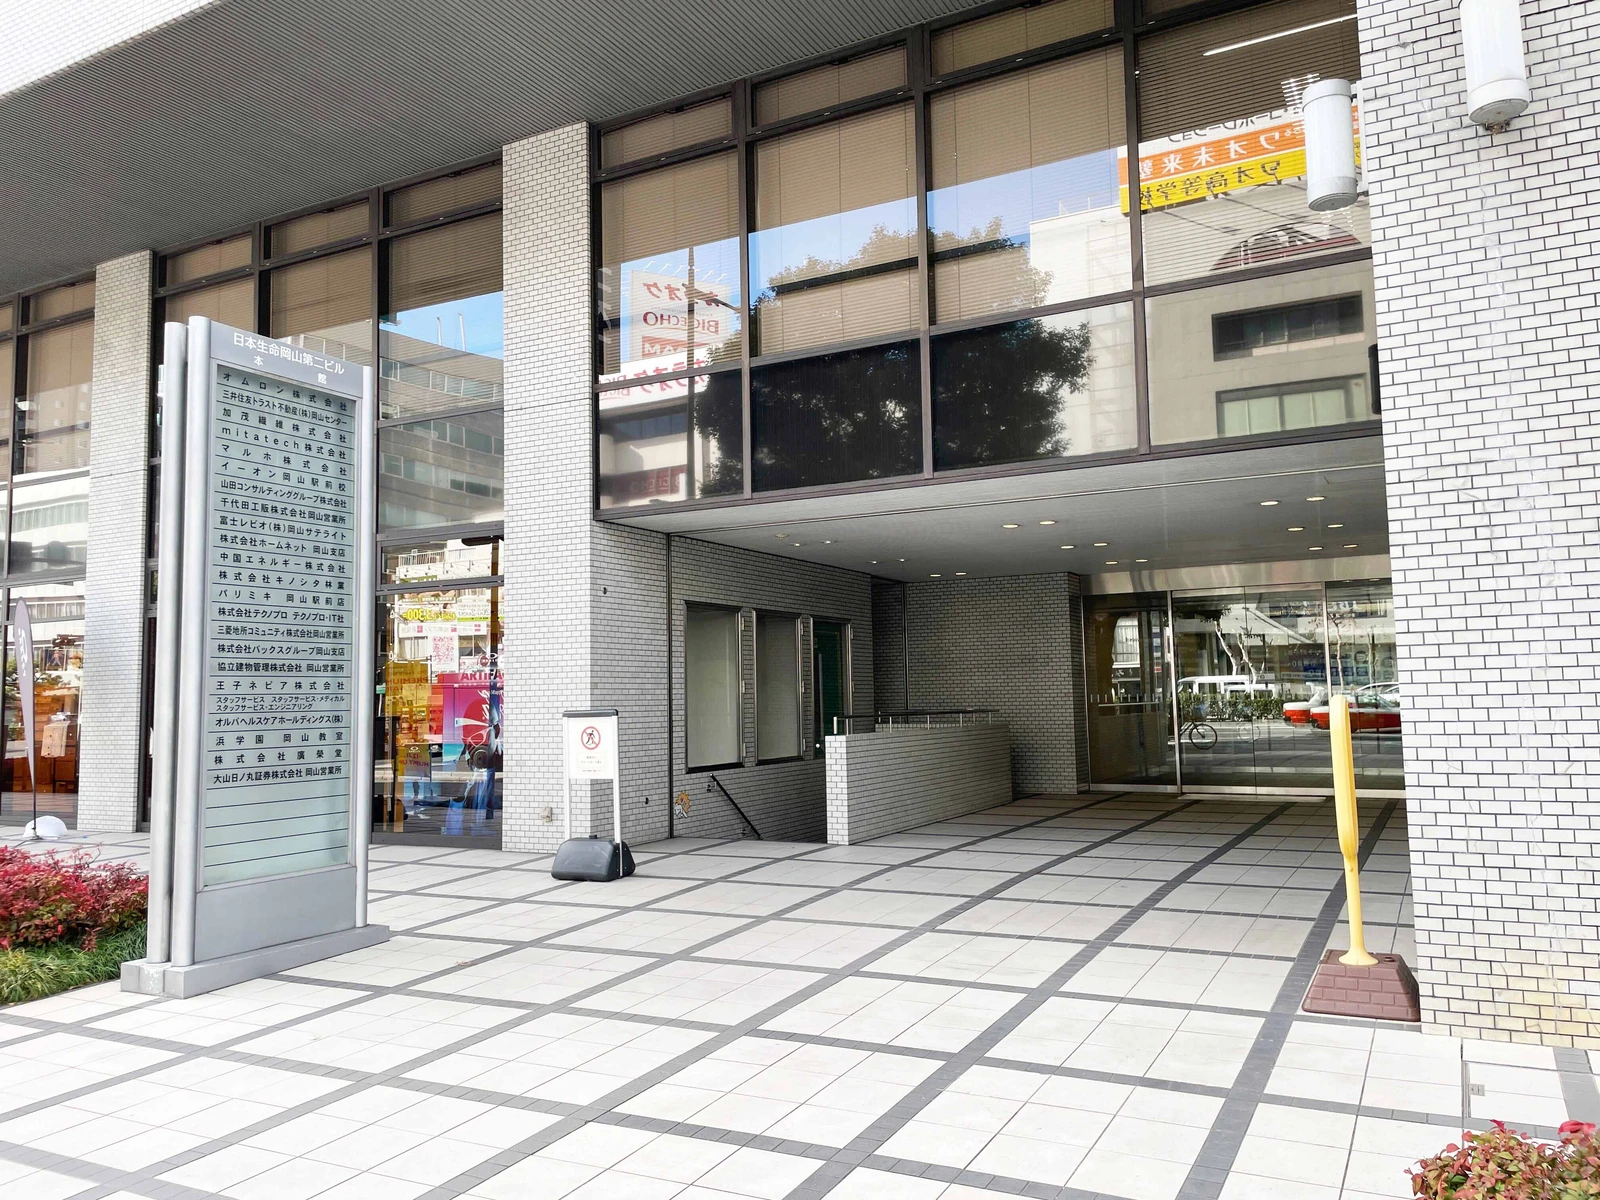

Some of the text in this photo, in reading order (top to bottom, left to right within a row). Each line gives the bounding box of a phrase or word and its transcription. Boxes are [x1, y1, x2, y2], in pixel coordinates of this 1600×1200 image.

[233, 332, 345, 375] 日本生命岡山第二ビル
[223, 372, 347, 412] オムロン株式会社
[222, 389, 347, 425] 三井住友トラスト不動産(株)岡山センター
[222, 407, 347, 443] 加茂繊維株式会社
[221, 444, 347, 476] マルホ株式会社
[221, 461, 346, 492] イーオン岡山駅前校
[221, 479, 347, 509] 山田コンサルティンググループ株式会社
[219, 533, 346, 558] 株式会社ホームネット 岡山支店
[220, 551, 346, 574] 中国エネルギー株式会社
[219, 570, 345, 590] 株式会社キノシタ林業
[286, 594, 345, 607] 岡山駅前店
[217, 661, 345, 673] 協立建物管理株式会社 岡山営業所
[216, 696, 265, 704] スタッフサービス
[215, 731, 343, 746] 浜学園 岡山教室
[213, 765, 342, 784] 大山日ノ丸証券株式会社 岡山営業所
